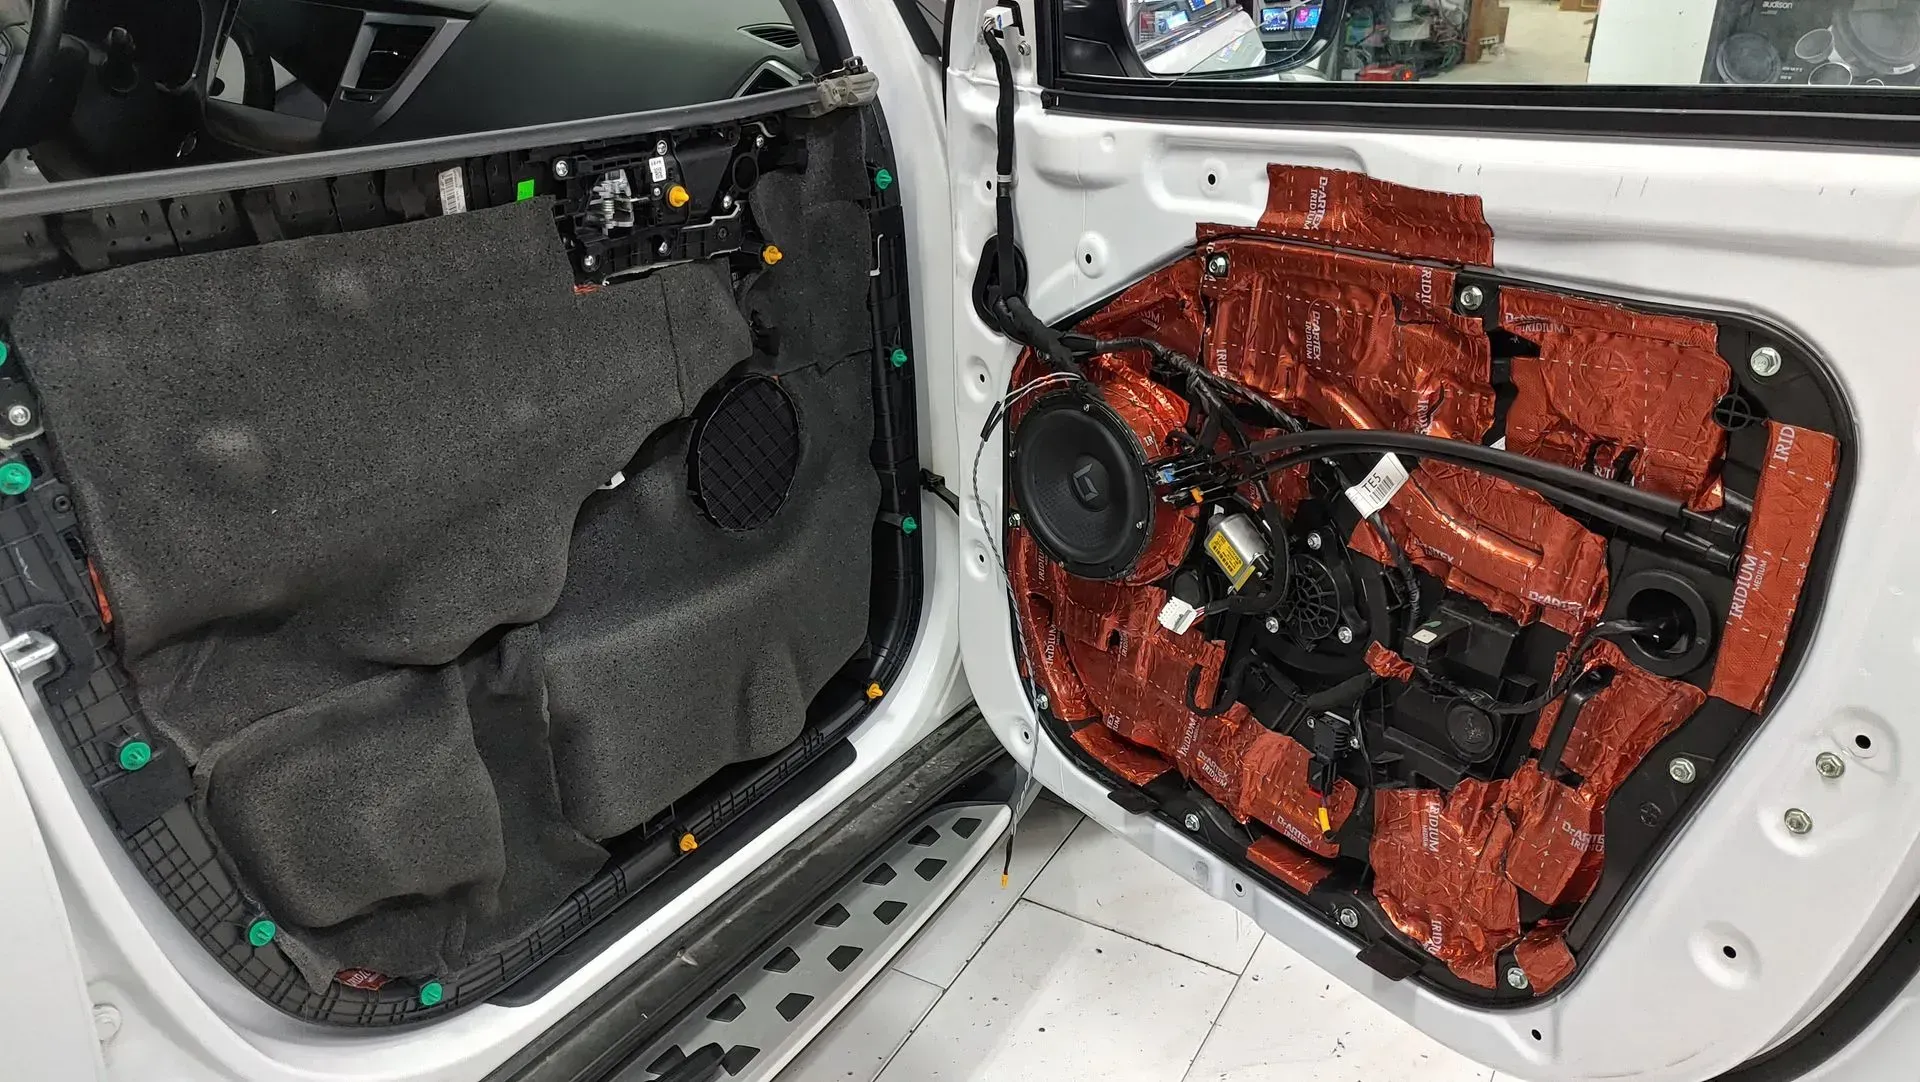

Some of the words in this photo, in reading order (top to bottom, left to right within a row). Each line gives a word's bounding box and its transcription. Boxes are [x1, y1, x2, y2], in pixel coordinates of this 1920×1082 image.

[1762, 0, 1793, 9] audison
[1303, 188, 1318, 230] IRIDIUM
[1305, 320, 1313, 360] IRIDIUM
[1361, 472, 1381, 493] TE5
[1728, 553, 1758, 621] IRIDIUM
[1752, 560, 1768, 592] MEDIUM
[1045, 624, 1057, 667] IRIDIUM
[1177, 717, 1198, 757] IRIDIUM
[1202, 763, 1228, 788] IRIDIUM
[1428, 801, 1441, 852] IRIDIUM
